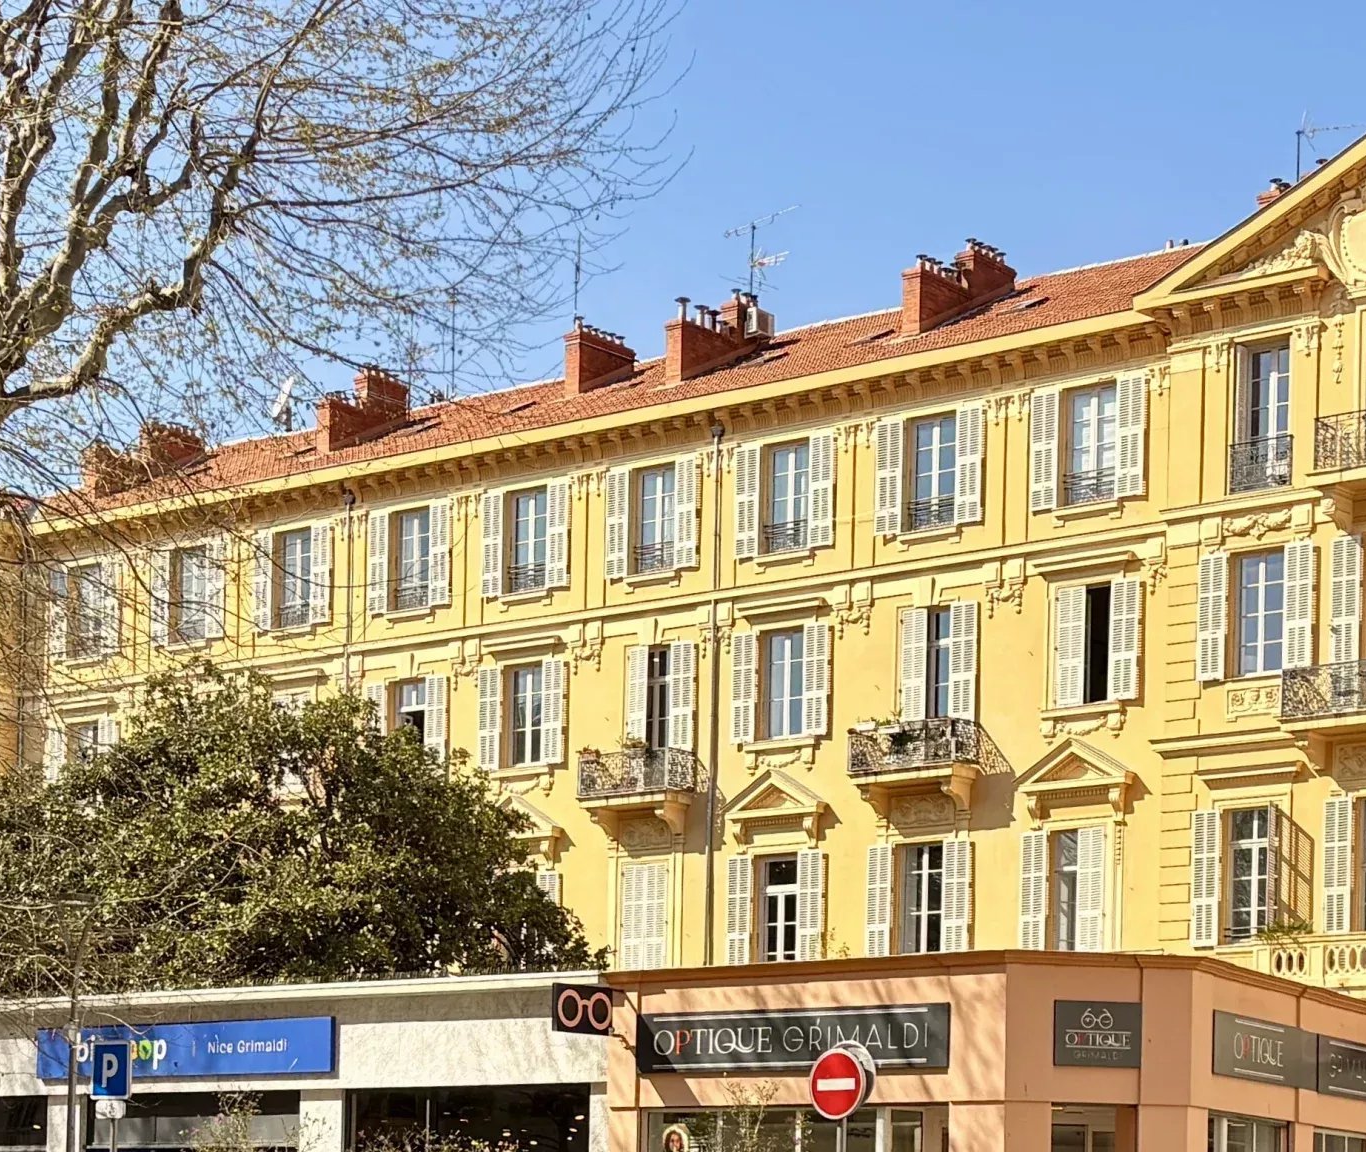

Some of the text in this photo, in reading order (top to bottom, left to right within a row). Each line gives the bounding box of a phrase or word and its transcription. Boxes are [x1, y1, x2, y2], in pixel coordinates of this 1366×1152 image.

[76, 1031, 287, 1070] biop Nice Grimaldi
[653, 1021, 929, 1056] OPTIQUE GRIMALDI
[1065, 1032, 1132, 1047] OPTIQUE
[1234, 1032, 1284, 1068] OPTIQUE
[101, 1052, 119, 1088] P
